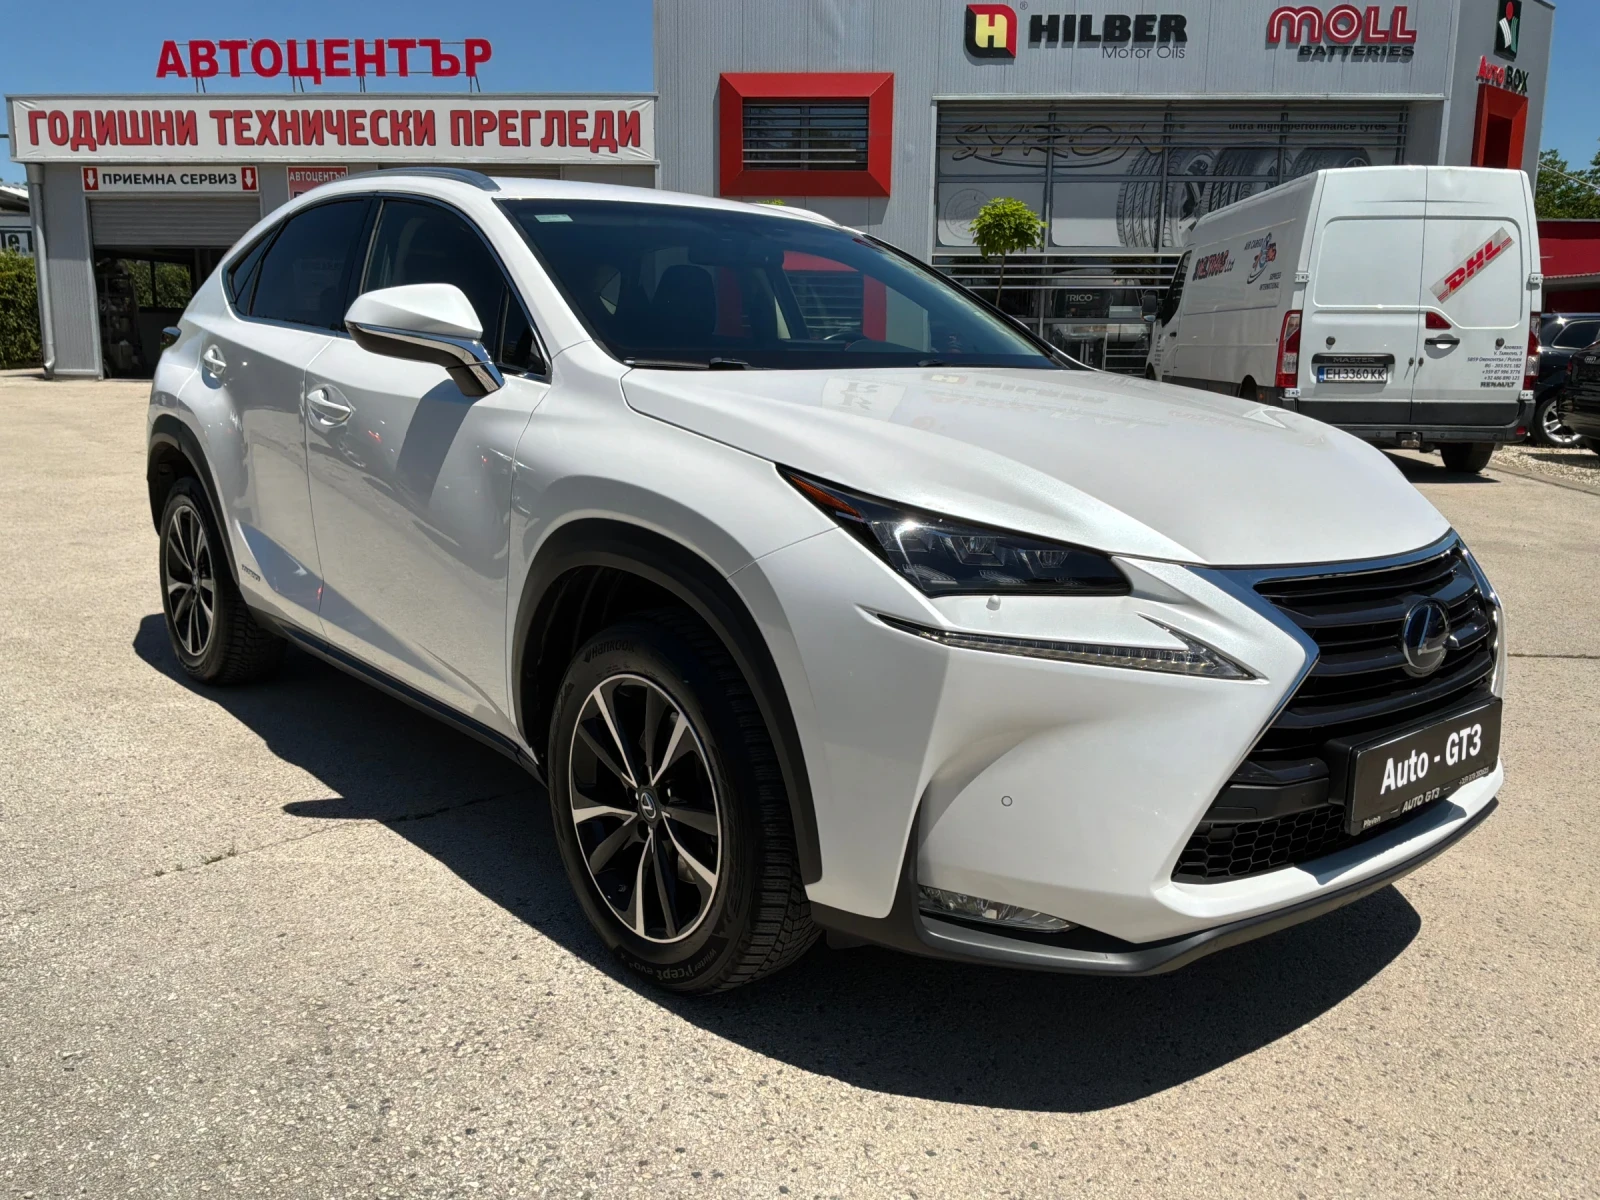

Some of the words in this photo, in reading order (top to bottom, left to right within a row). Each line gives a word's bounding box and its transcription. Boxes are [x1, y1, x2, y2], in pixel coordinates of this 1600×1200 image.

[1030, 14, 1188, 43] HILBER
[156, 38, 492, 85] АВТОЦЕНТЪР
[1102, 46, 1152, 59] Motor
[1156, 46, 1186, 59] Oils
[1300, 45, 1415, 56] BATTERIES
[27, 109, 199, 152] ГОДИШНИ
[209, 109, 437, 147] ТЕХНИЧЕСКИ
[450, 109, 641, 154] ПРЕГЛЕДИ
[102, 173, 175, 185] ПРИЕМНА
[183, 172, 237, 185] СЕРВИЗ
[1444, 240, 1501, 293] DHL
[1379, 749, 1429, 795] Auto
[1445, 723, 1482, 766] GT3
[1402, 795, 1424, 813] AUTO
[1425, 787, 1441, 803] GT3
